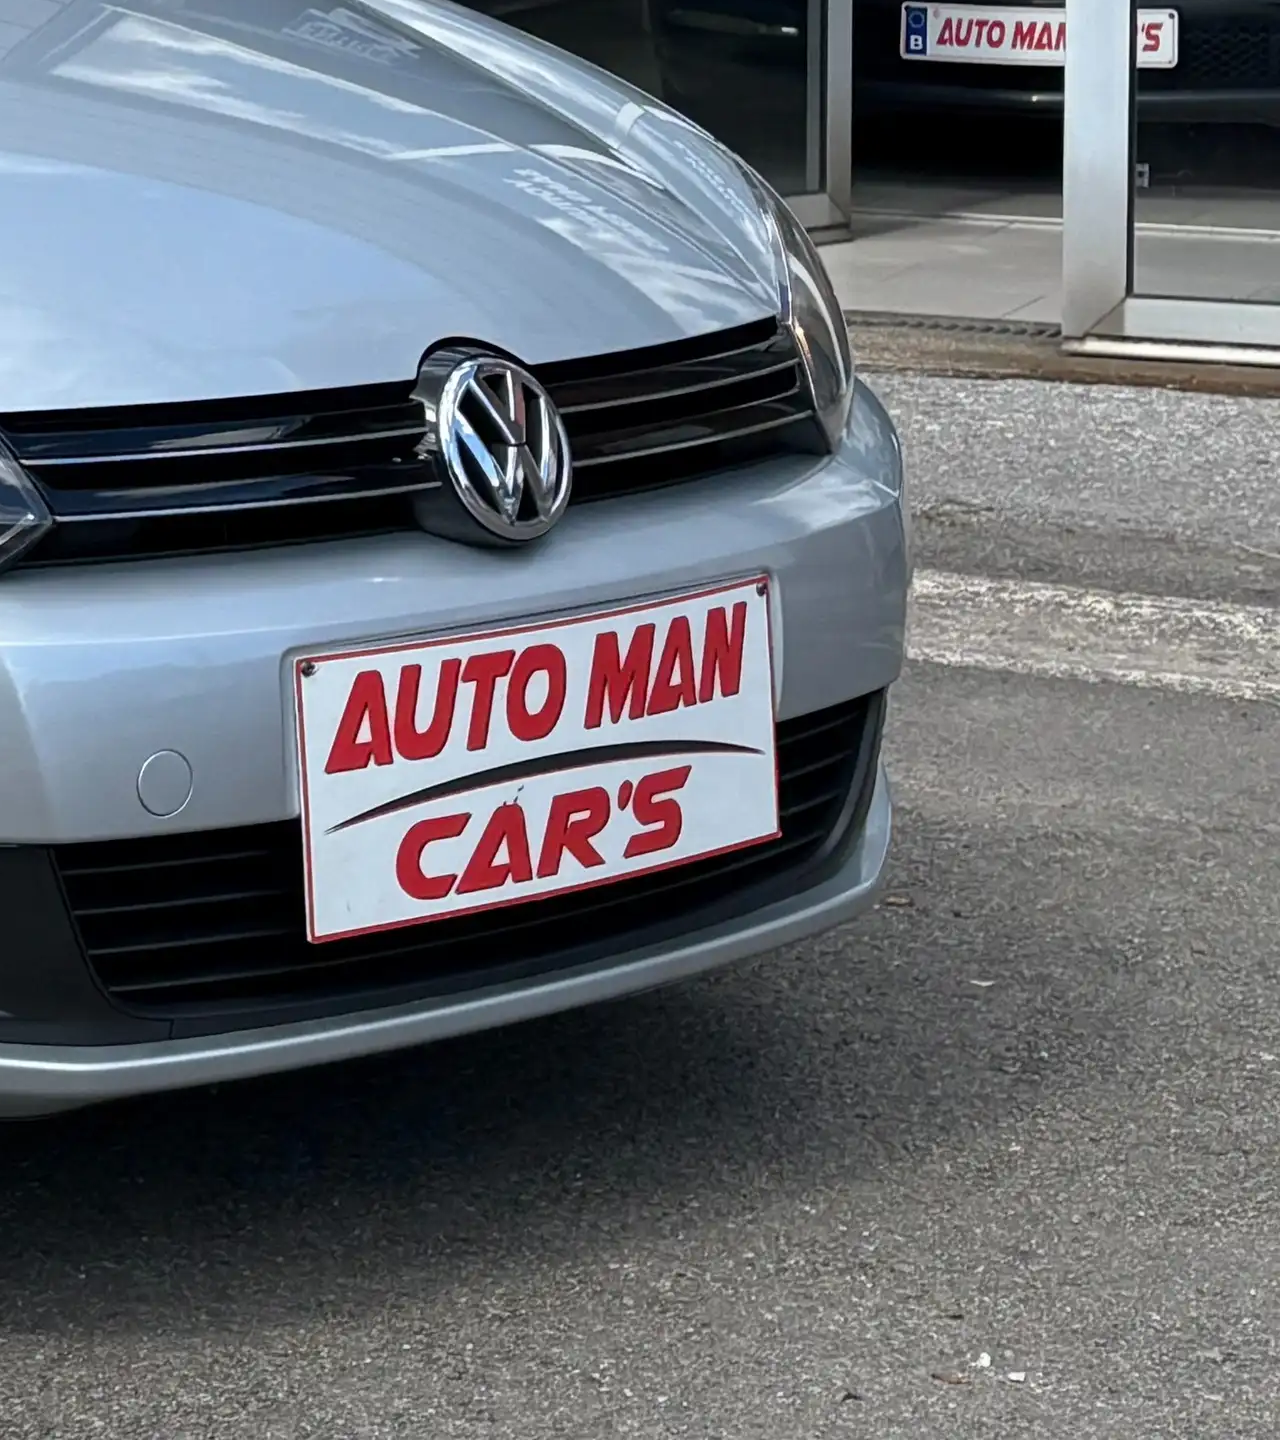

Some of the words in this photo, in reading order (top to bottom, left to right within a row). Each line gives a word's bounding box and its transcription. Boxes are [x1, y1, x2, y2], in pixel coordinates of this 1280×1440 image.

[909, 34, 923, 51] B
[936, 17, 1006, 49] AUTO
[323, 642, 567, 775] AUTO
[584, 601, 748, 731] MAN
[394, 764, 693, 902] CAR'S
